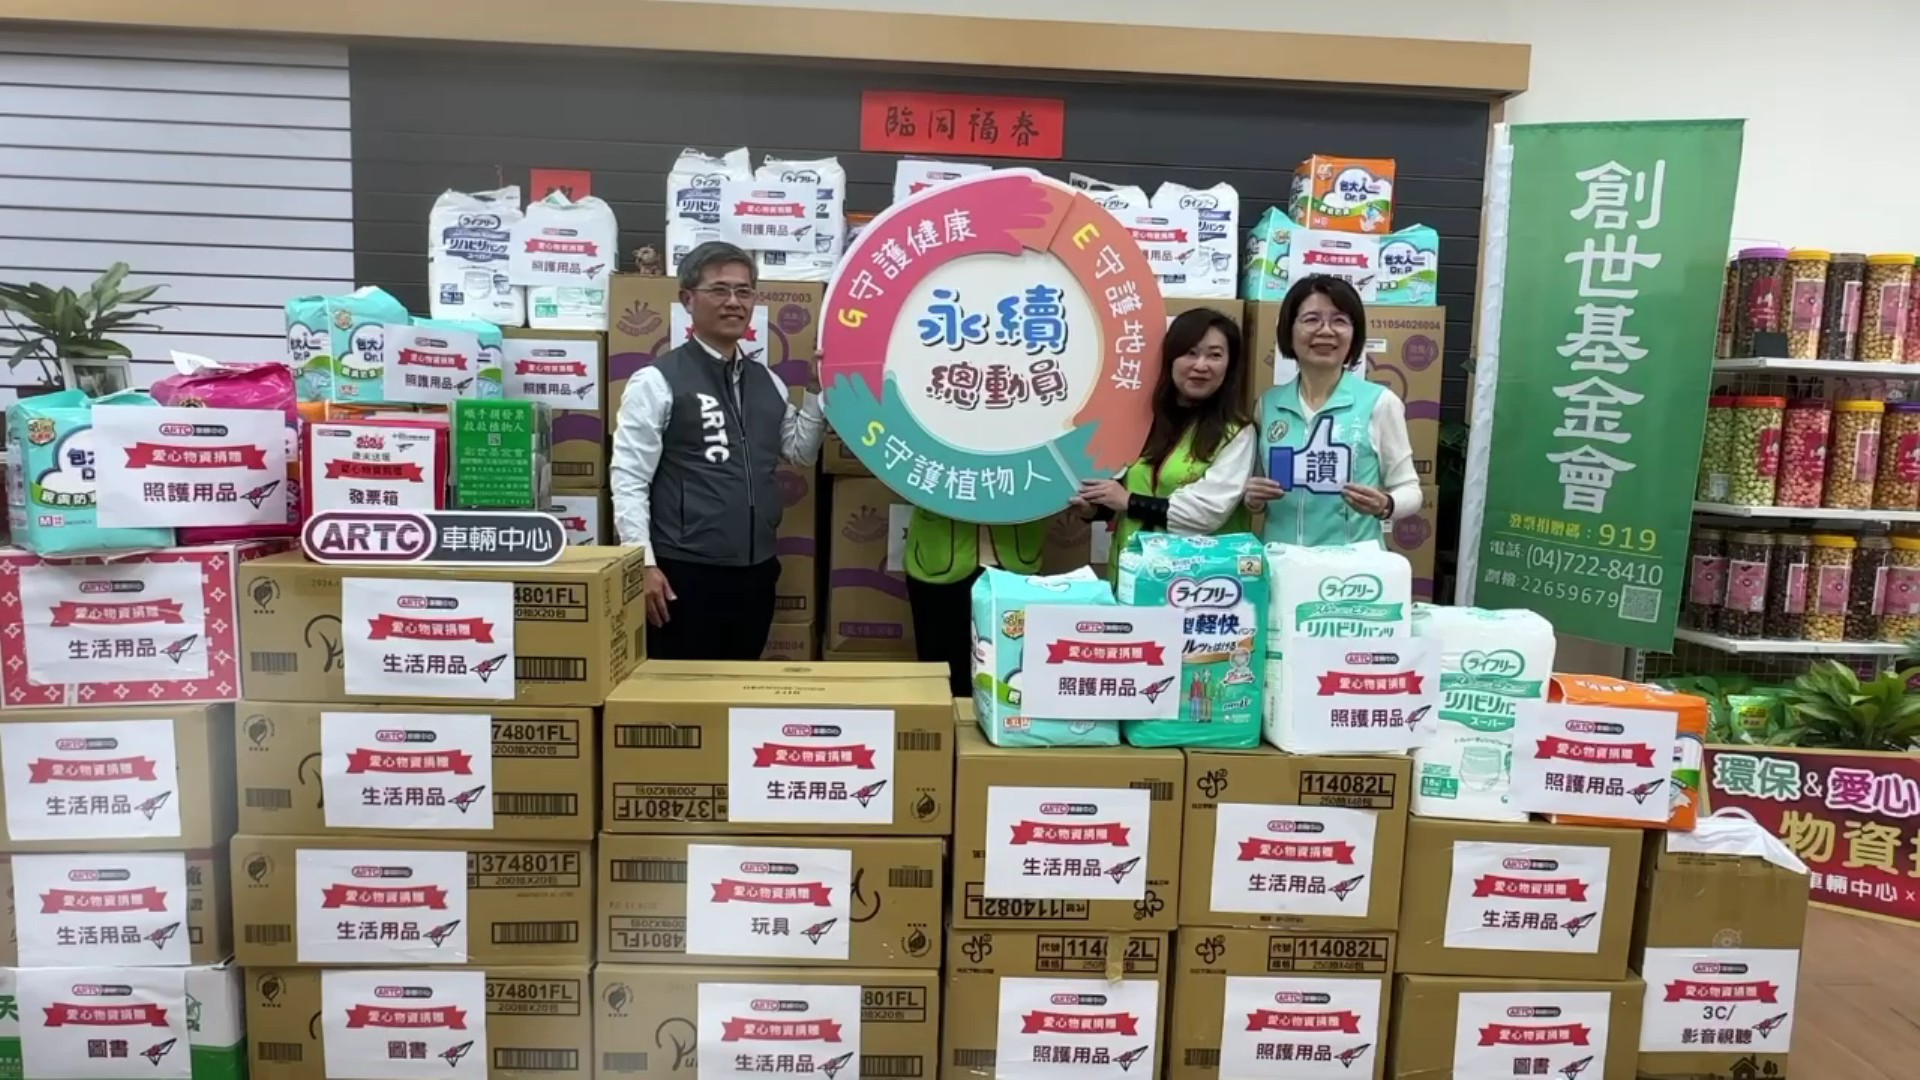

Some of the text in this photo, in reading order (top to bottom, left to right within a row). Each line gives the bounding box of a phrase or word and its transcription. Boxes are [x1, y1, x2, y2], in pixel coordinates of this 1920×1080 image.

[847, 208, 978, 301] 守護健康
[754, 291, 812, 303] 54027003
[1072, 223, 1148, 392] E 守護地球
[917, 284, 1067, 352] 永續
[1546, 158, 1665, 514] 創世基金會
[405, 373, 453, 390] 照護用品
[523, 382, 572, 396] 照護用品
[925, 359, 1068, 411] 總動員
[697, 393, 730, 464] ARTC
[152, 450, 243, 464] 愛心物資捐贈
[860, 420, 1052, 501] S 守護植物人
[1305, 450, 1339, 485] 讚
[143, 482, 238, 503] 照護用品
[349, 488, 399, 507] 發票箱
[320, 522, 553, 552] ARTC 車輛中心
[1598, 524, 1657, 552] 919
[1526, 543, 1664, 586] (04)722-8410
[1176, 586, 1236, 603] ライフリー
[1325, 584, 1375, 598] ライフリー
[1520, 575, 1620, 609] 22659679
[75, 605, 160, 620] 愛心物資捐贈
[392, 621, 472, 636] 愛心物資捐贈
[67, 638, 157, 660] 生活用品
[1069, 645, 1143, 660] 愛心物資捐贈
[382, 653, 468, 675] 生活用品
[1467, 657, 1517, 672] ライフリー
[1057, 676, 1137, 697] 照護用品
[1330, 708, 1404, 728] 照護用品
[774, 749, 853, 763] 愛心物資捐贈
[1556, 742, 1633, 760] 愛心物資捐贈
[51, 762, 134, 776] 愛心物資捐贈
[369, 753, 450, 769] 愛心物資捐贈
[766, 780, 849, 801] 生活用品
[1303, 775, 1391, 794] 114082L
[1544, 772, 1625, 797] 照護用品
[1714, 754, 1801, 801] 環保
[1826, 767, 1920, 818] 愛心
[45, 794, 132, 816] 生活用品
[361, 786, 446, 807] 生活用品
[617, 799, 711, 819] 374801F
[1032, 826, 1108, 840] 愛心物資捐贈
[1259, 842, 1334, 858] 愛心物資捐贈
[1779, 810, 1920, 878] 物資
[482, 856, 575, 872] 374801F
[1022, 857, 1102, 877] 生活用品
[733, 885, 811, 901] 愛心物資捐贈
[1248, 873, 1327, 895] 生活用品
[1494, 880, 1568, 896] 愛心物資捐贈
[63, 894, 144, 907] 愛心物資捐贈
[345, 889, 426, 904] 愛心物資捐贈
[970, 899, 1060, 917] 114082L
[751, 917, 791, 937] 玩具
[1481, 910, 1559, 931] 生活用品
[56, 925, 142, 945] 生活用品
[336, 921, 421, 941] 生活用品
[1067, 939, 1155, 958] 1142L
[1298, 939, 1383, 958] 114082L
[486, 983, 573, 1000] 374801FL
[864, 990, 919, 1006] 801FL
[1685, 984, 1759, 1000] 愛心物資捐贈
[66, 1008, 147, 1022] 愛心物資捐贈
[368, 1009, 445, 1025] 愛心物資捐贈
[1043, 1016, 1117, 1029] 愛心物資捐贈
[1267, 1014, 1340, 1028] 愛心物資捐贈
[1702, 1005, 1736, 1021] 3C/
[743, 1023, 821, 1038] 愛心物資捐贈
[1499, 1027, 1571, 1042] 愛心物資捐贈
[1681, 1028, 1753, 1046] 影音視聽
[87, 1038, 129, 1058] 圖書
[387, 1040, 428, 1060] 圖書
[1032, 1045, 1110, 1065] 照護用品
[1255, 1043, 1332, 1062] 照護用品
[734, 1053, 816, 1074] 生活用品
[1513, 1057, 1551, 1076] 圖書
